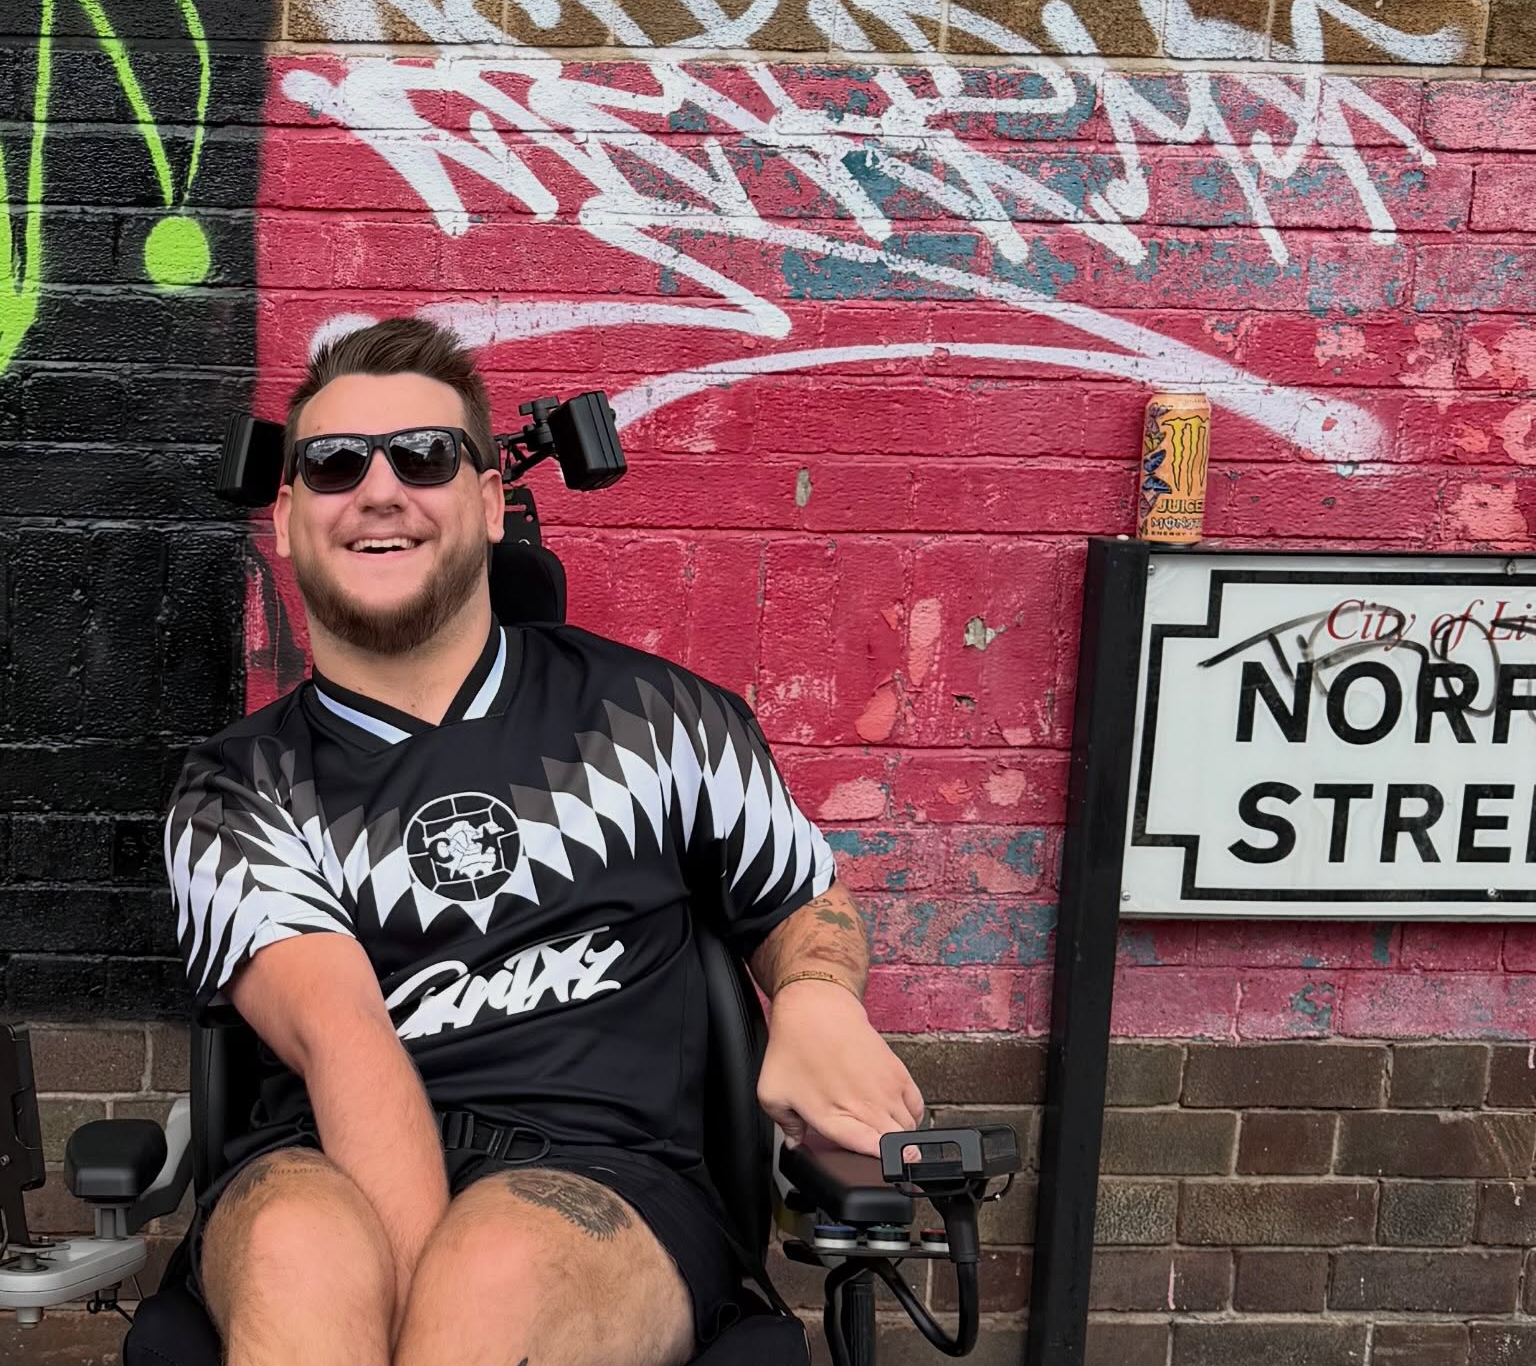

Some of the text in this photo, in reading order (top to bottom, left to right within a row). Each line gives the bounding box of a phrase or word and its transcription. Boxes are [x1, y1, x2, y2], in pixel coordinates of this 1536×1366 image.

[1157, 498, 1205, 513] JUICE
[1326, 598, 1536, 652] City of Li
[1235, 660, 1536, 745] NORF
[1227, 781, 1536, 864] STRE
